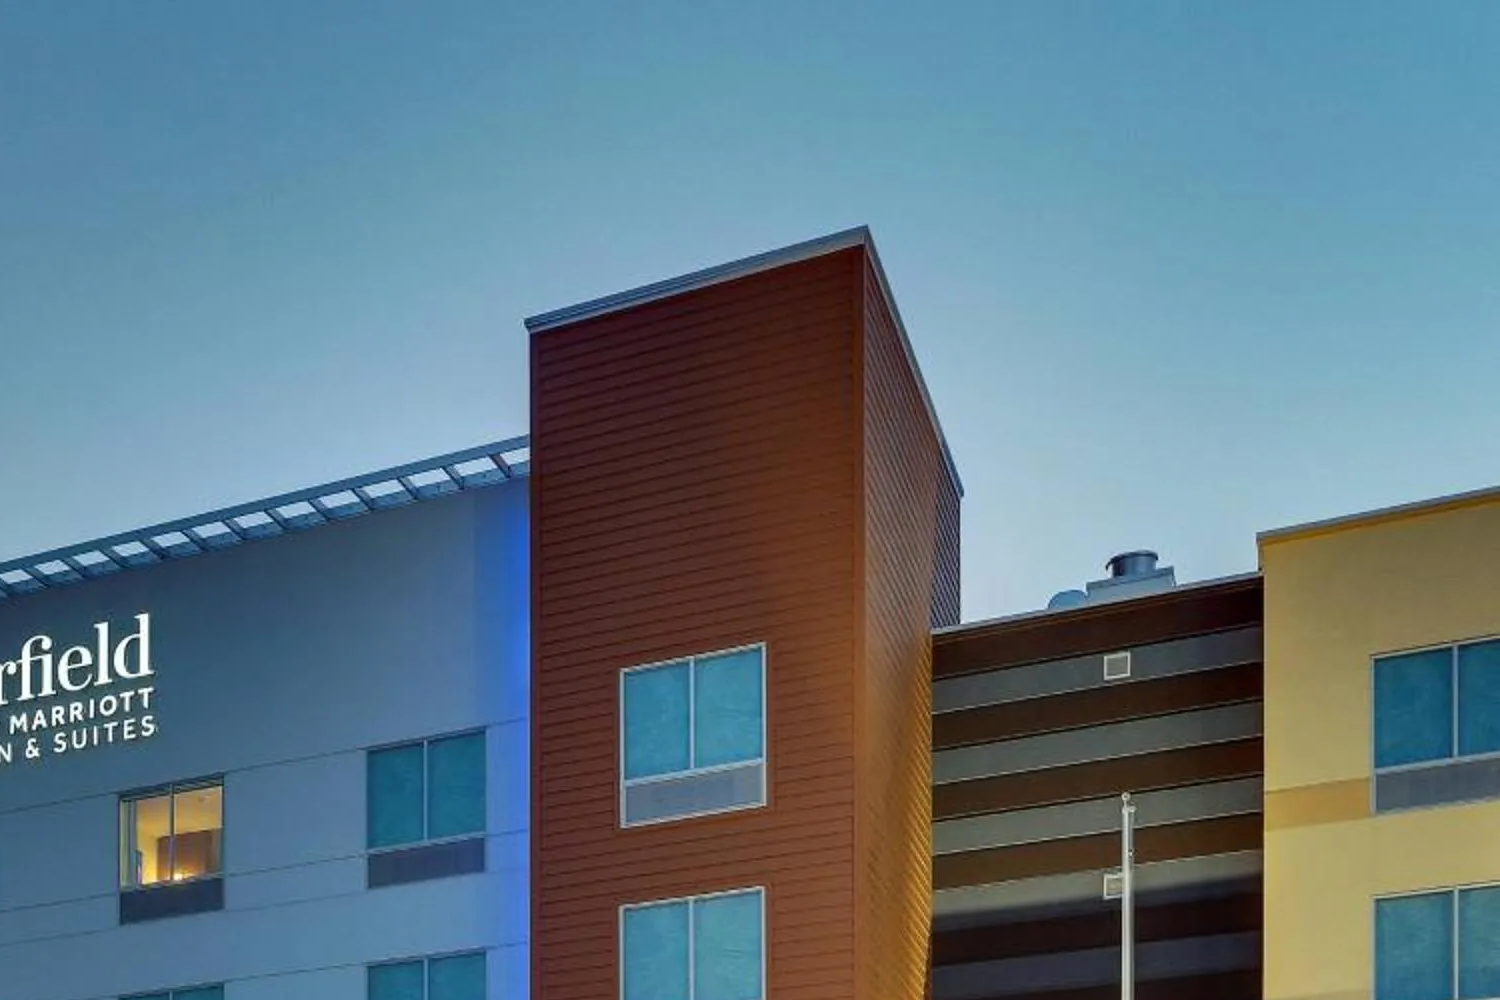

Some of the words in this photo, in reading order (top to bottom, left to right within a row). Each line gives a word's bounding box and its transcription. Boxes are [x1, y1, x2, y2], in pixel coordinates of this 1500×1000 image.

[9, 687, 155, 735] MARRIOTT
[25, 738, 40, 759] &
[53, 716, 156, 753] SUITES
